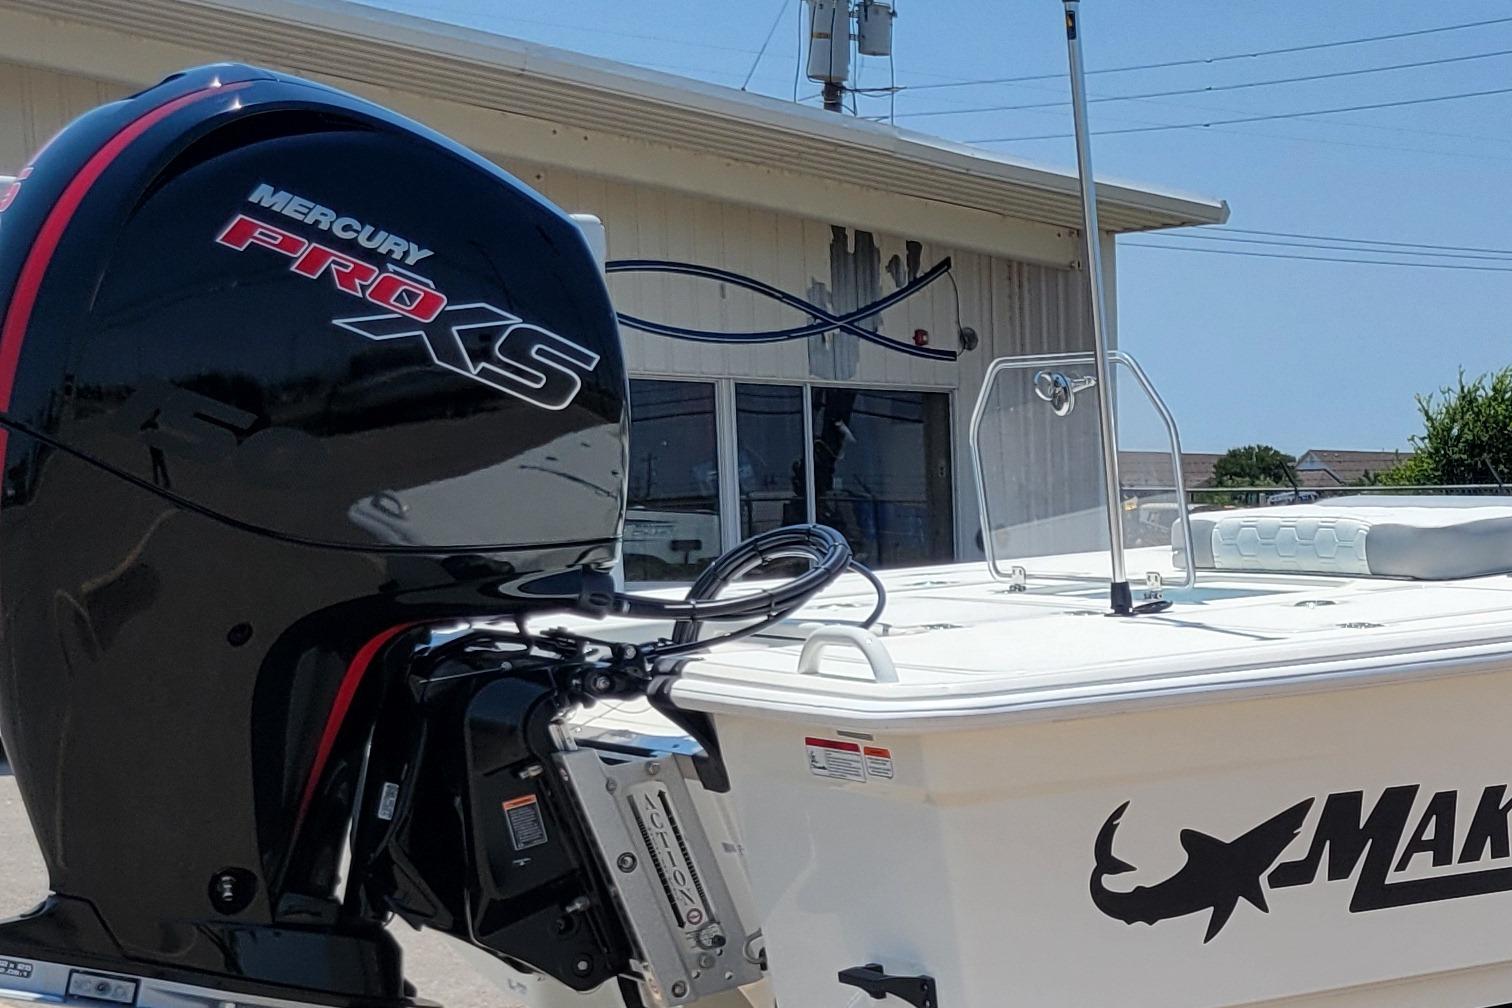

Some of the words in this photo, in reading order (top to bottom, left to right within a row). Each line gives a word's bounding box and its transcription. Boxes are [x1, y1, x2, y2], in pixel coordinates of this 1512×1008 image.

[216, 214, 448, 323] PRO
[248, 183, 434, 266] MERCURY
[331, 302, 600, 411] XS
